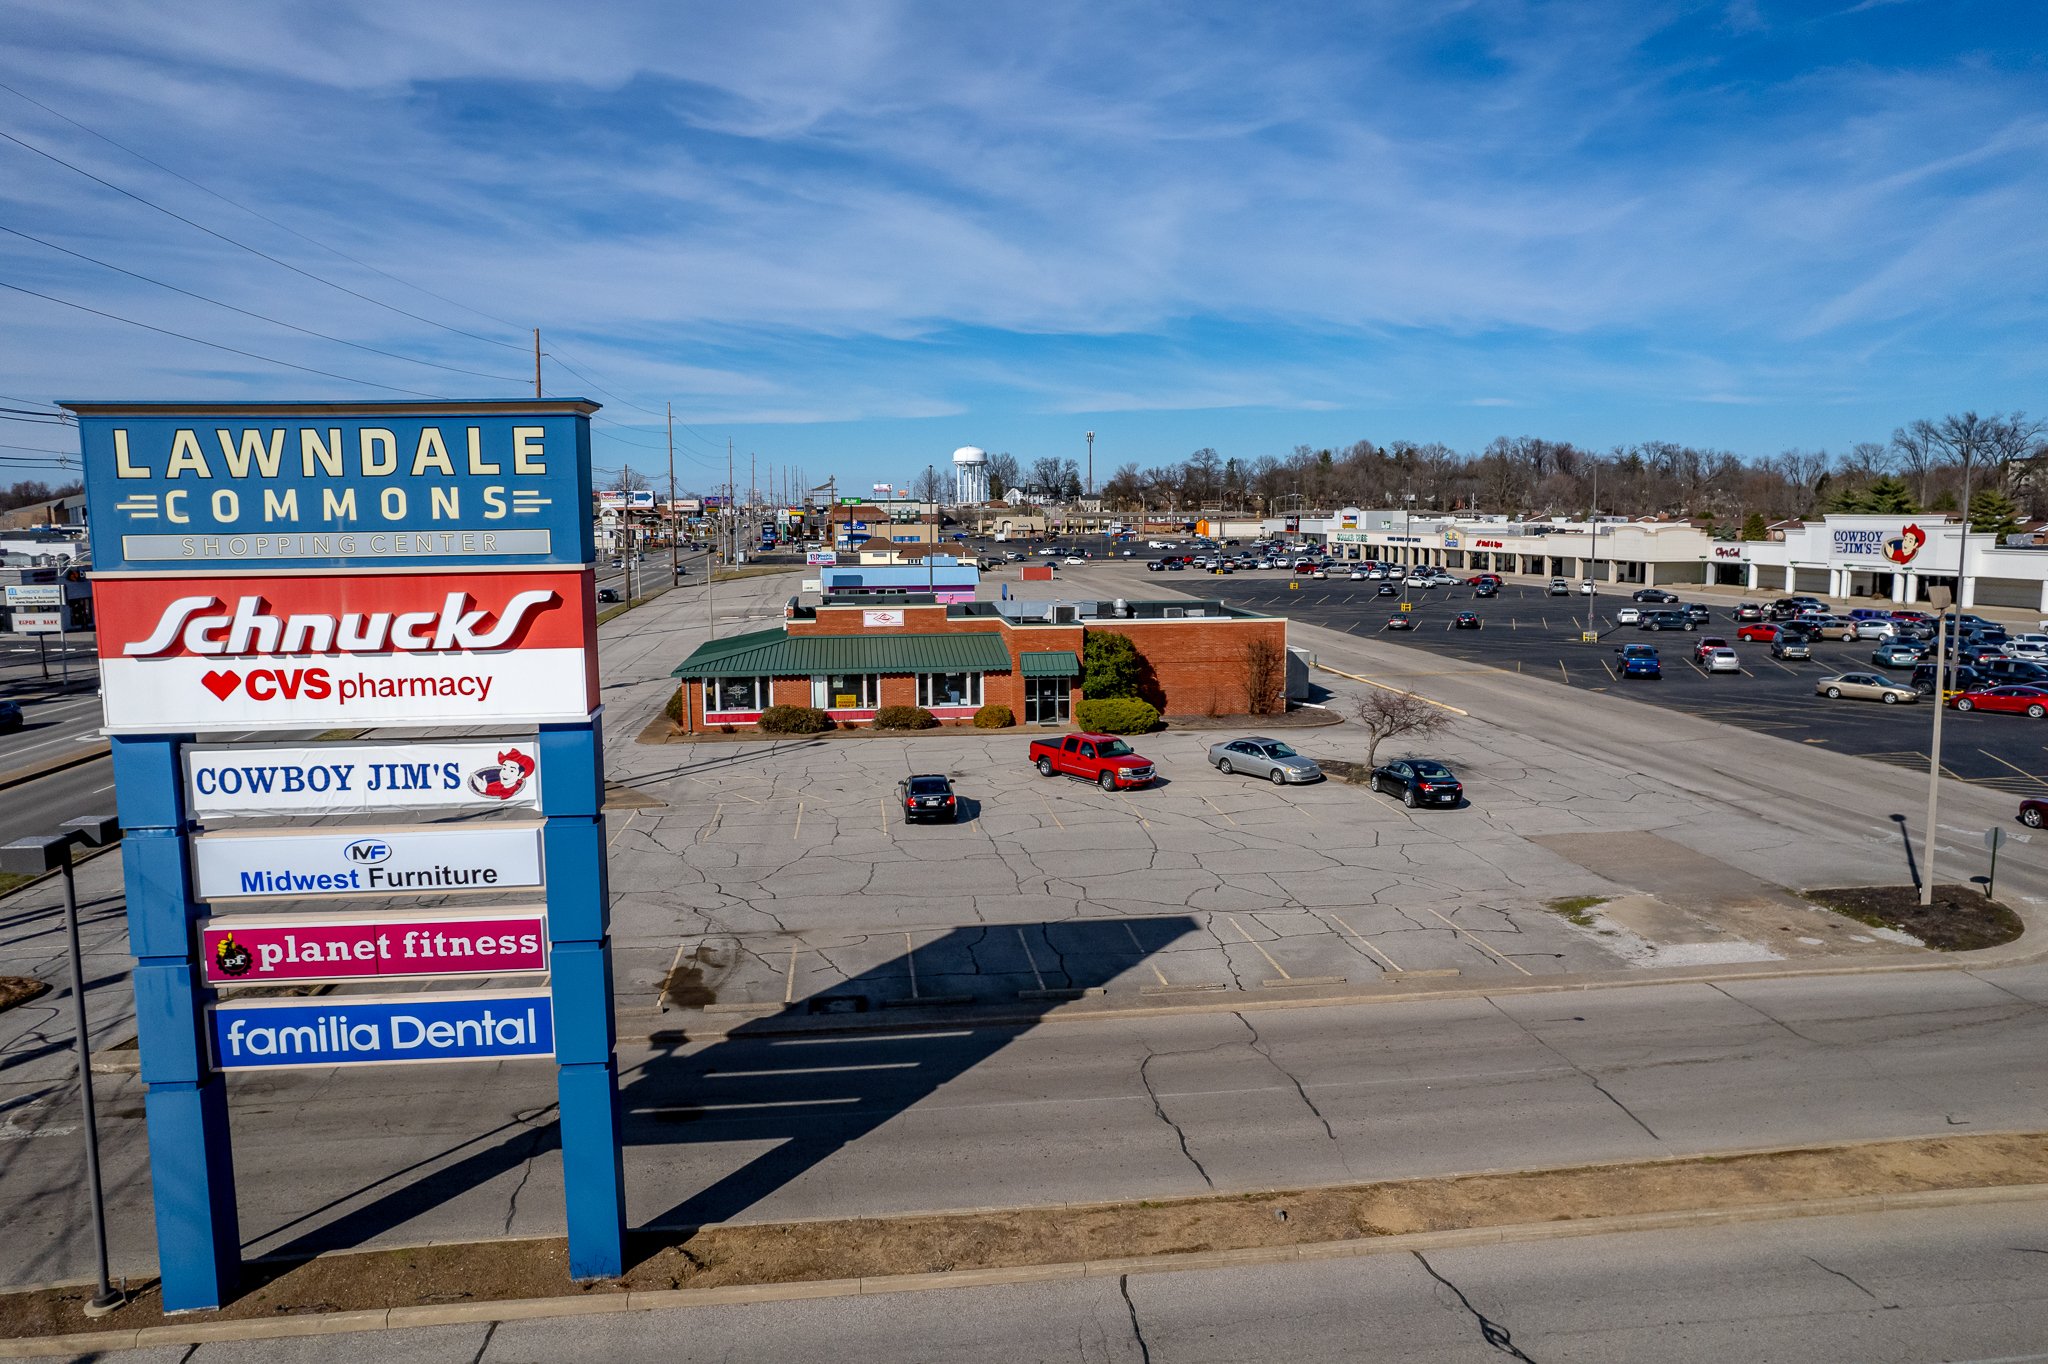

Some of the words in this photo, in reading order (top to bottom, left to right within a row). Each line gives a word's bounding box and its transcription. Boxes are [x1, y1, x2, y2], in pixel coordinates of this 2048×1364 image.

[113, 426, 547, 479] LAWNDALE
[165, 485, 507, 524] COMMONS
[182, 534, 357, 556] SHOPPING
[370, 532, 498, 553] CENTER
[1833, 529, 1883, 543] COWBOY
[1842, 542, 1872, 555] JIM'S
[122, 589, 554, 658] Schnucks
[245, 668, 332, 702] CVS
[339, 671, 493, 705] pharmacy
[196, 764, 355, 795] COWBOY
[367, 762, 461, 791] JIM'S
[240, 869, 360, 893] Midwest
[369, 865, 498, 888] Furniture
[223, 954, 246, 968] pf
[257, 934, 391, 973] planet
[404, 931, 539, 957] fitness
[228, 1015, 381, 1056] familia
[390, 1008, 537, 1049] Dental
